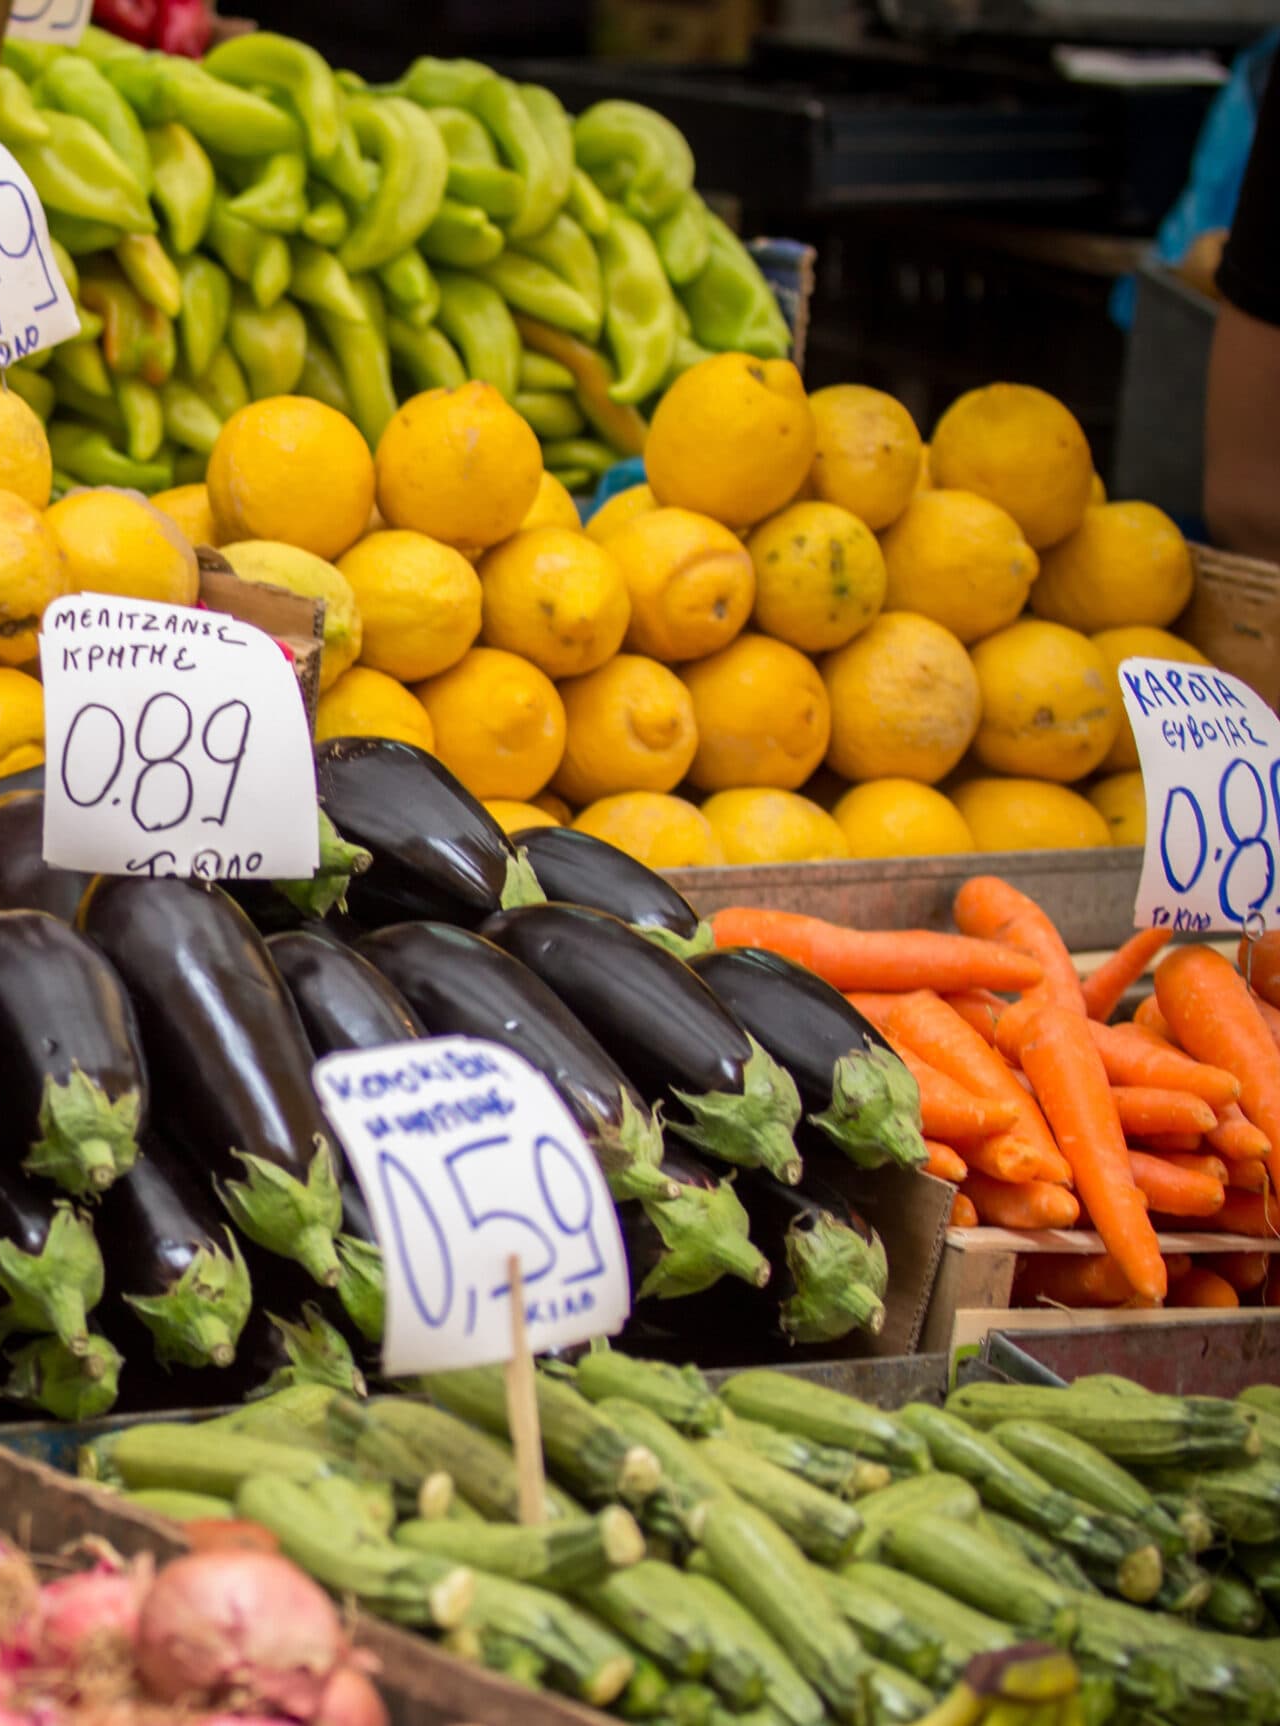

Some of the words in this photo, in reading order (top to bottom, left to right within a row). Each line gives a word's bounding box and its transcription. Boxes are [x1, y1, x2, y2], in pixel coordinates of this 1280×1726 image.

[62, 643, 197, 673] ΚΡΗΤΗΣ
[1123, 668, 1247, 717] ΚΑΡΟΤΑ
[61, 692, 252, 832] 0.89
[1160, 757, 1280, 924] 0.8
